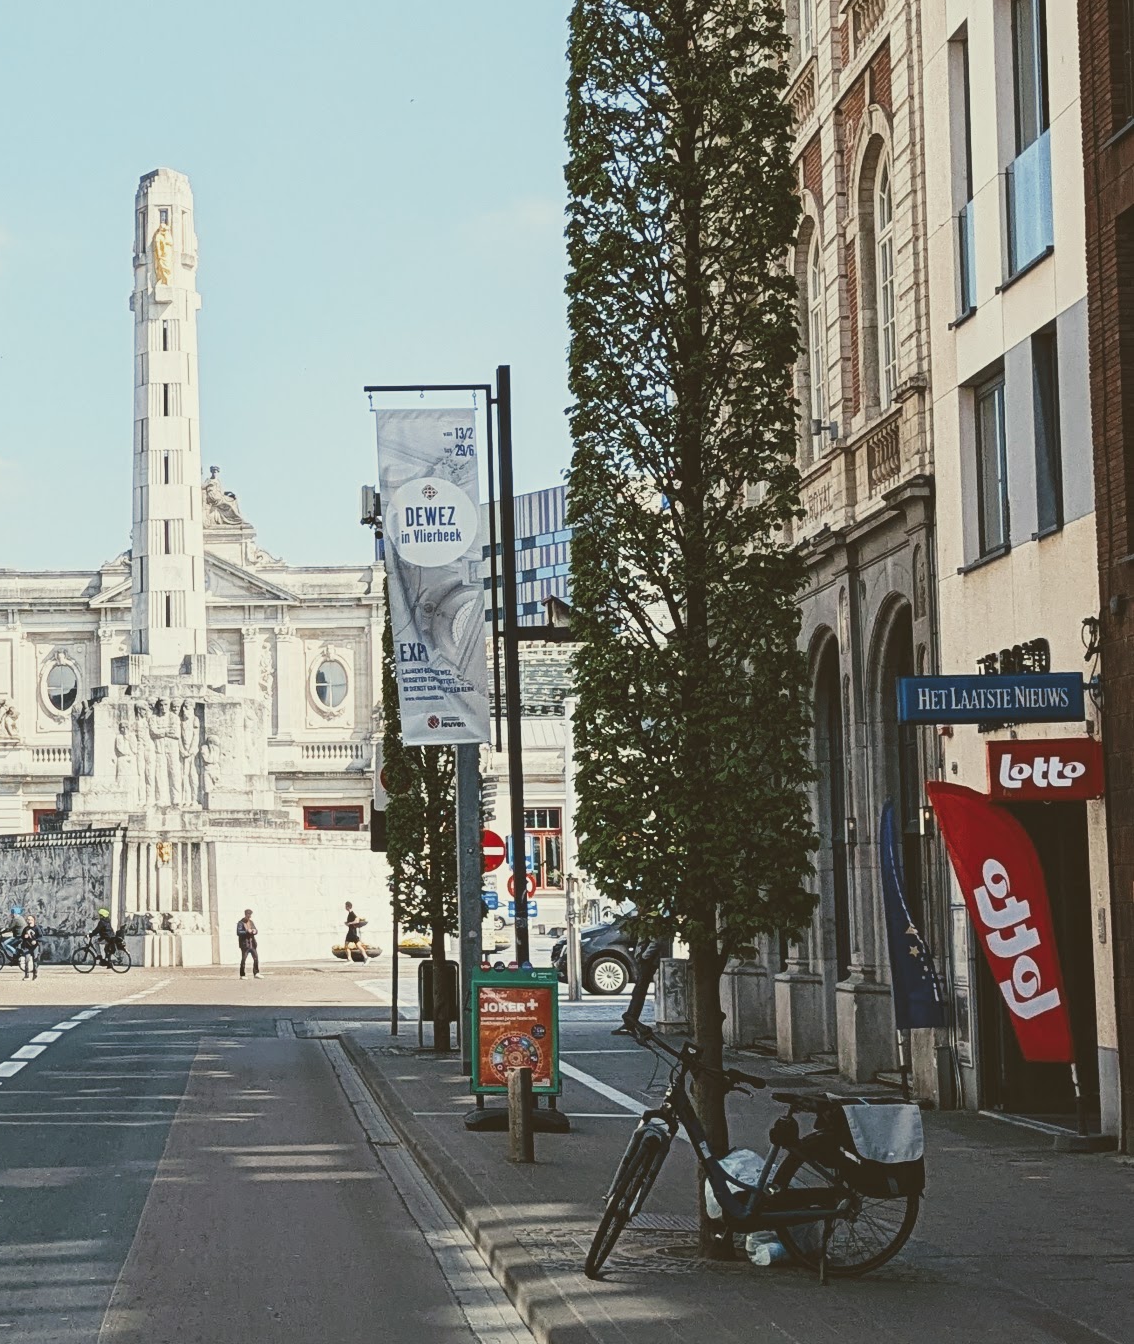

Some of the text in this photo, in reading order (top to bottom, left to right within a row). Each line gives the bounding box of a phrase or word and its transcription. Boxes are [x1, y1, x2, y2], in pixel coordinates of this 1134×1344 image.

[455, 427, 474, 441] 13/2
[455, 444, 475, 457] 29/6
[405, 506, 456, 527] DEWEZ
[401, 528, 462, 544] in Vlierbeek
[918, 685, 1069, 710] HET LAATSTE NIEUWS
